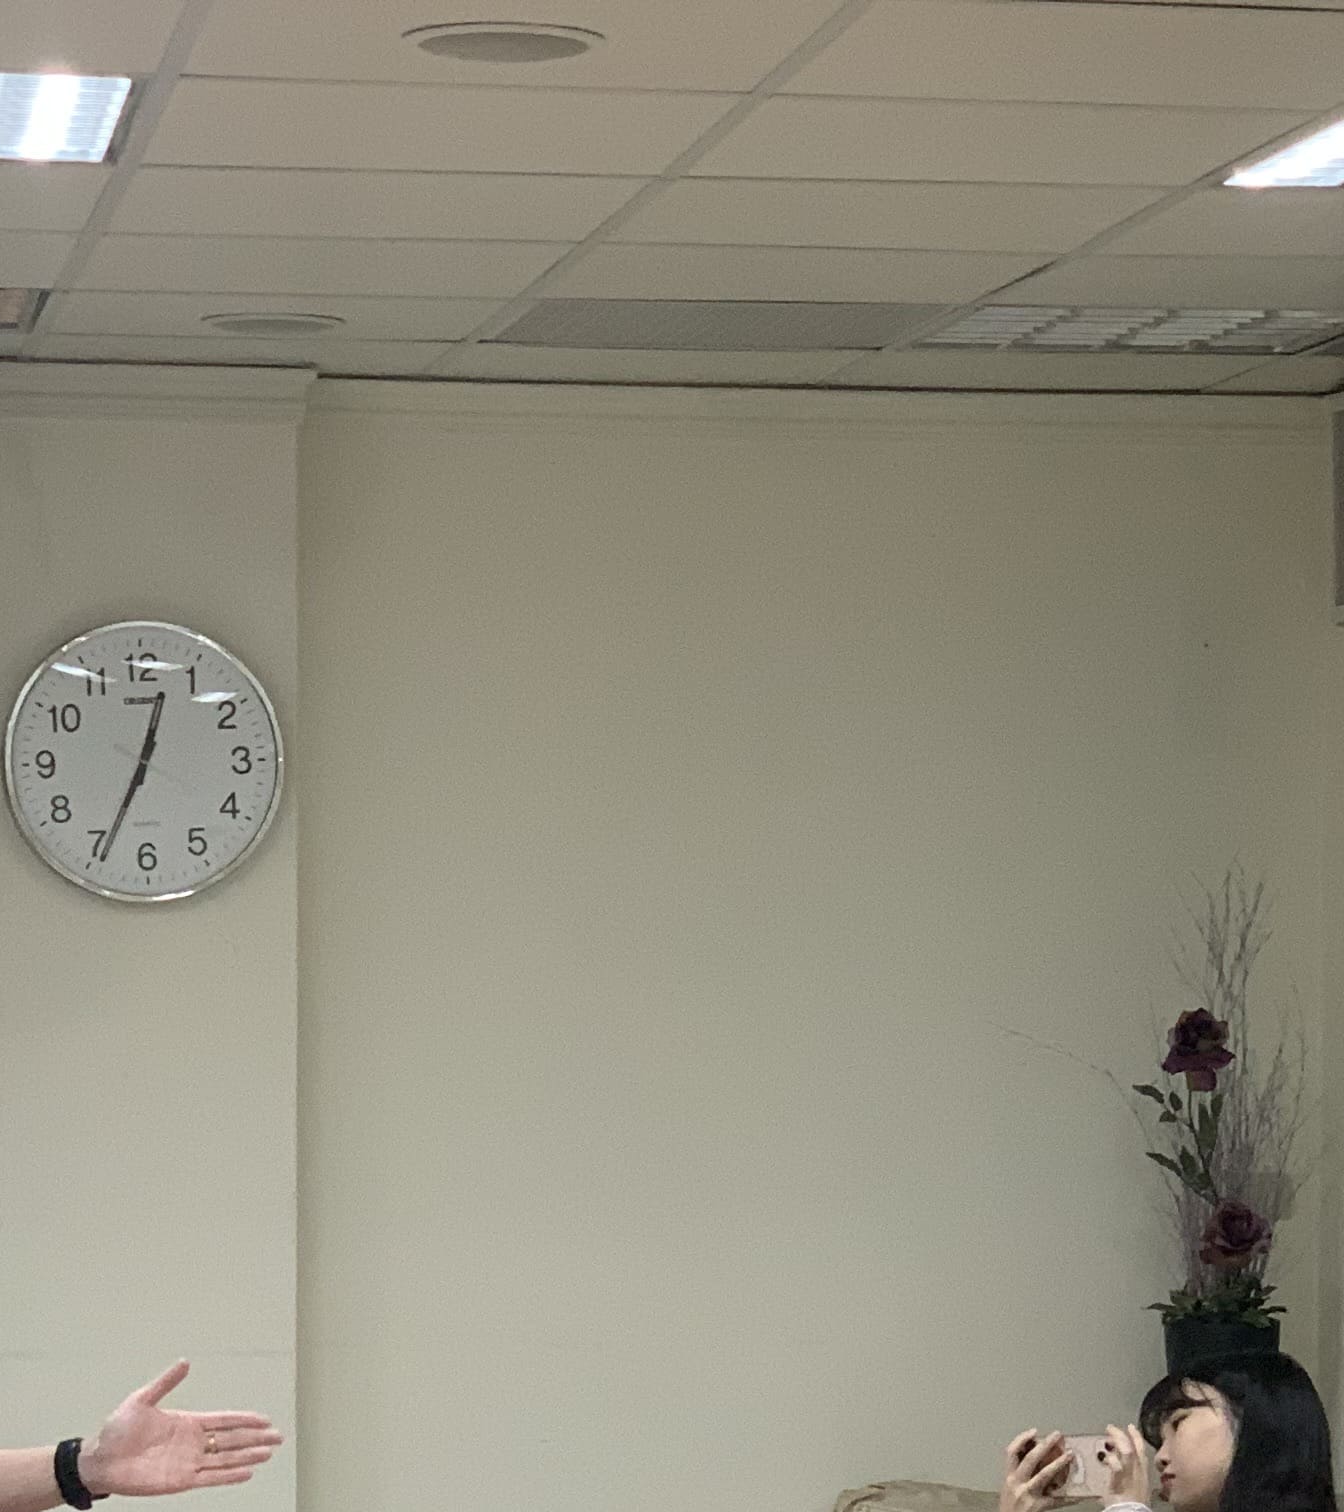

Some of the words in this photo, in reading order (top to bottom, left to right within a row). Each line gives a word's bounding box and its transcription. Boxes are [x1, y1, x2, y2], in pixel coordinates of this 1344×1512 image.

[124, 652, 158, 682] 12
[185, 665, 196, 694] 1
[85, 667, 107, 697] 11
[47, 703, 81, 733] 10
[217, 700, 237, 730] 2
[35, 750, 57, 779] 9
[231, 746, 252, 775] 3
[50, 795, 72, 824] 8
[219, 792, 241, 820] 4
[86, 829, 107, 858] 7
[187, 828, 207, 856] 5
[137, 843, 158, 871] 6
